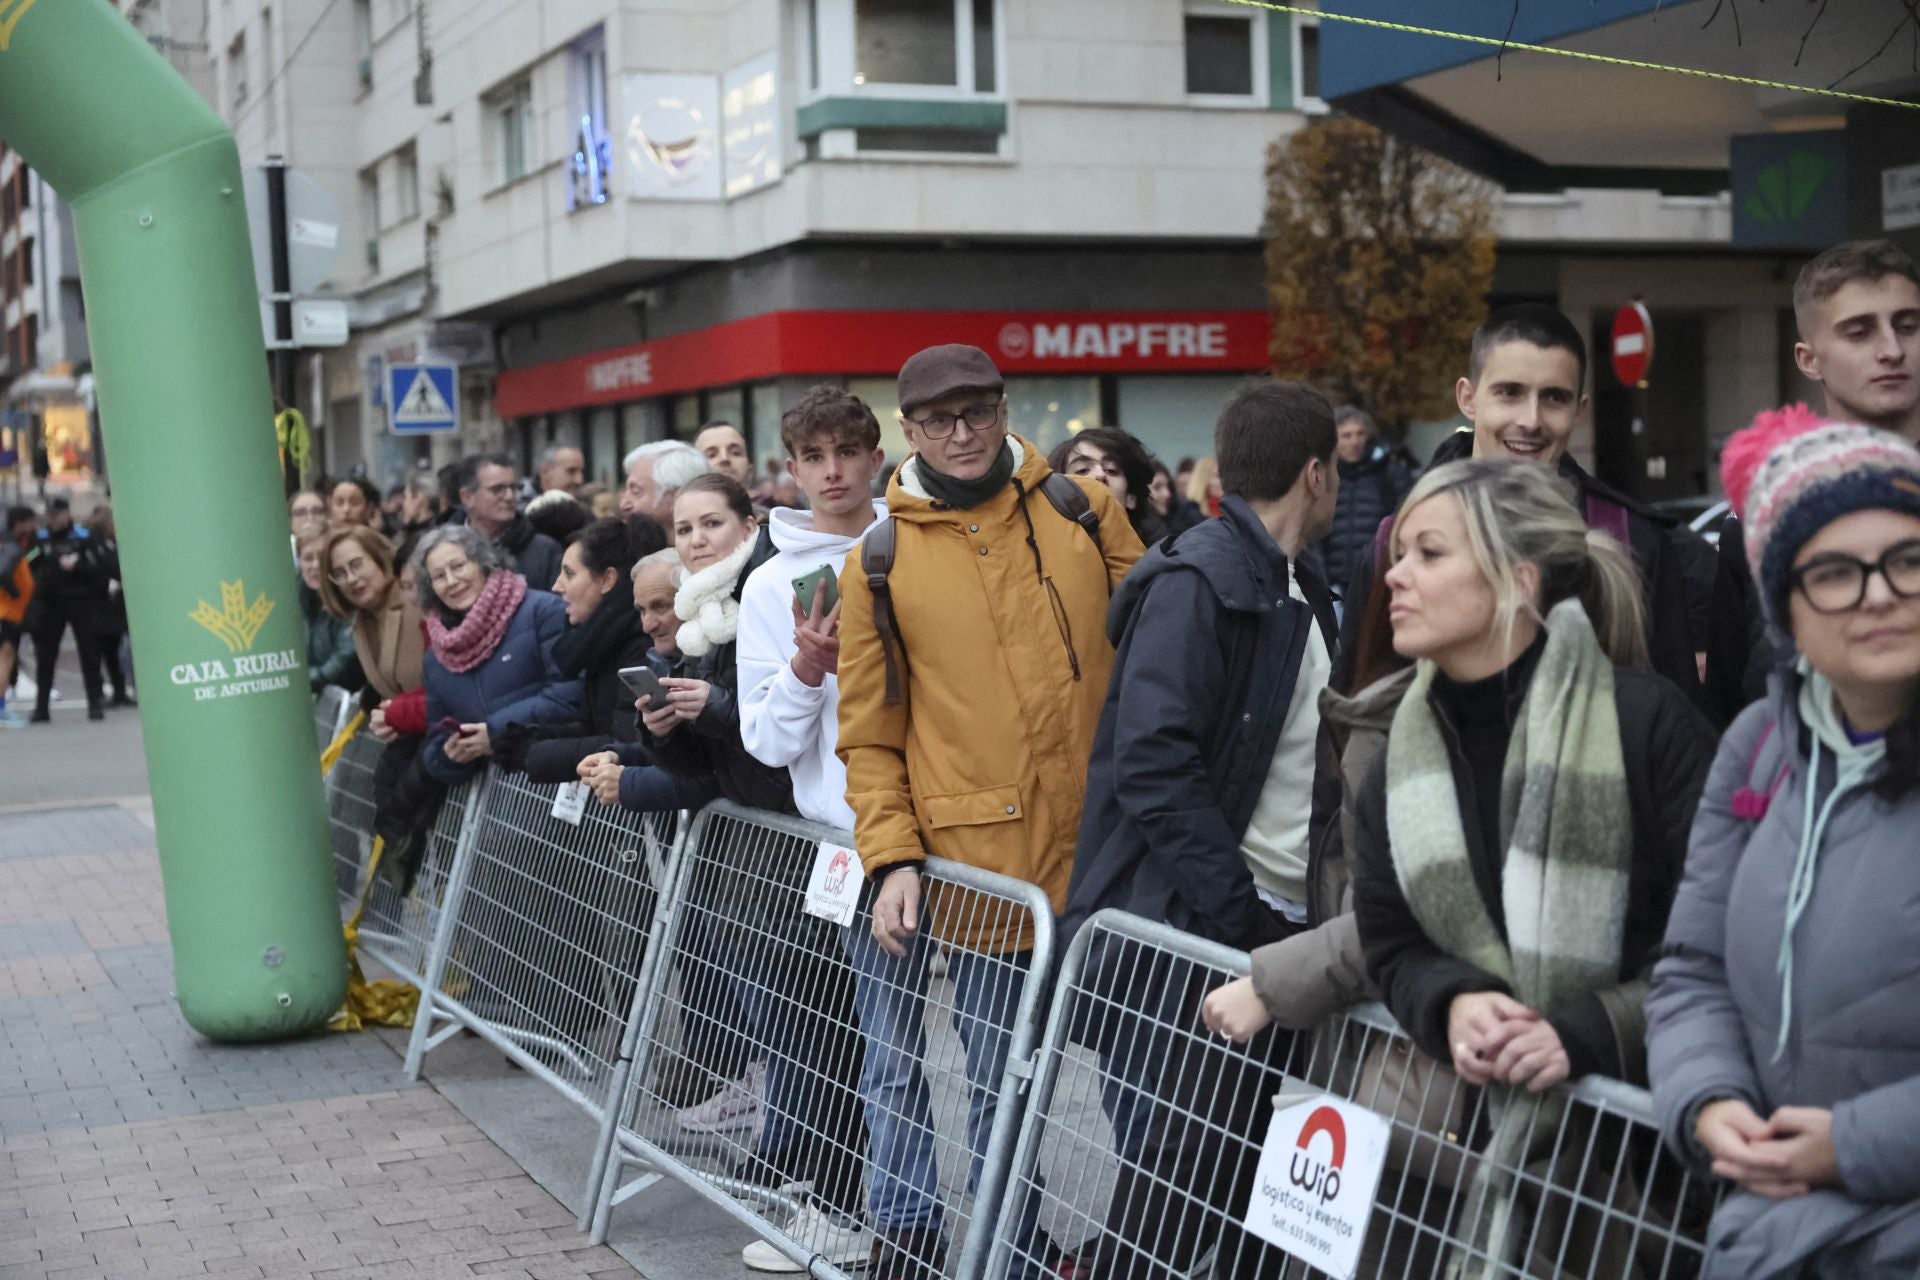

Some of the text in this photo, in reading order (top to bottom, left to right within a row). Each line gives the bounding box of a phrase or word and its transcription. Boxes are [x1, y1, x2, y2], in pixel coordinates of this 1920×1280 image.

[1032, 323, 1227, 358] MAPFRE
[170, 649, 300, 685] CAJA RURAL
[194, 675, 290, 701] DE ASTURIAS
[1305, 1202, 1314, 1225] y
[1314, 1209, 1353, 1237] eventos
